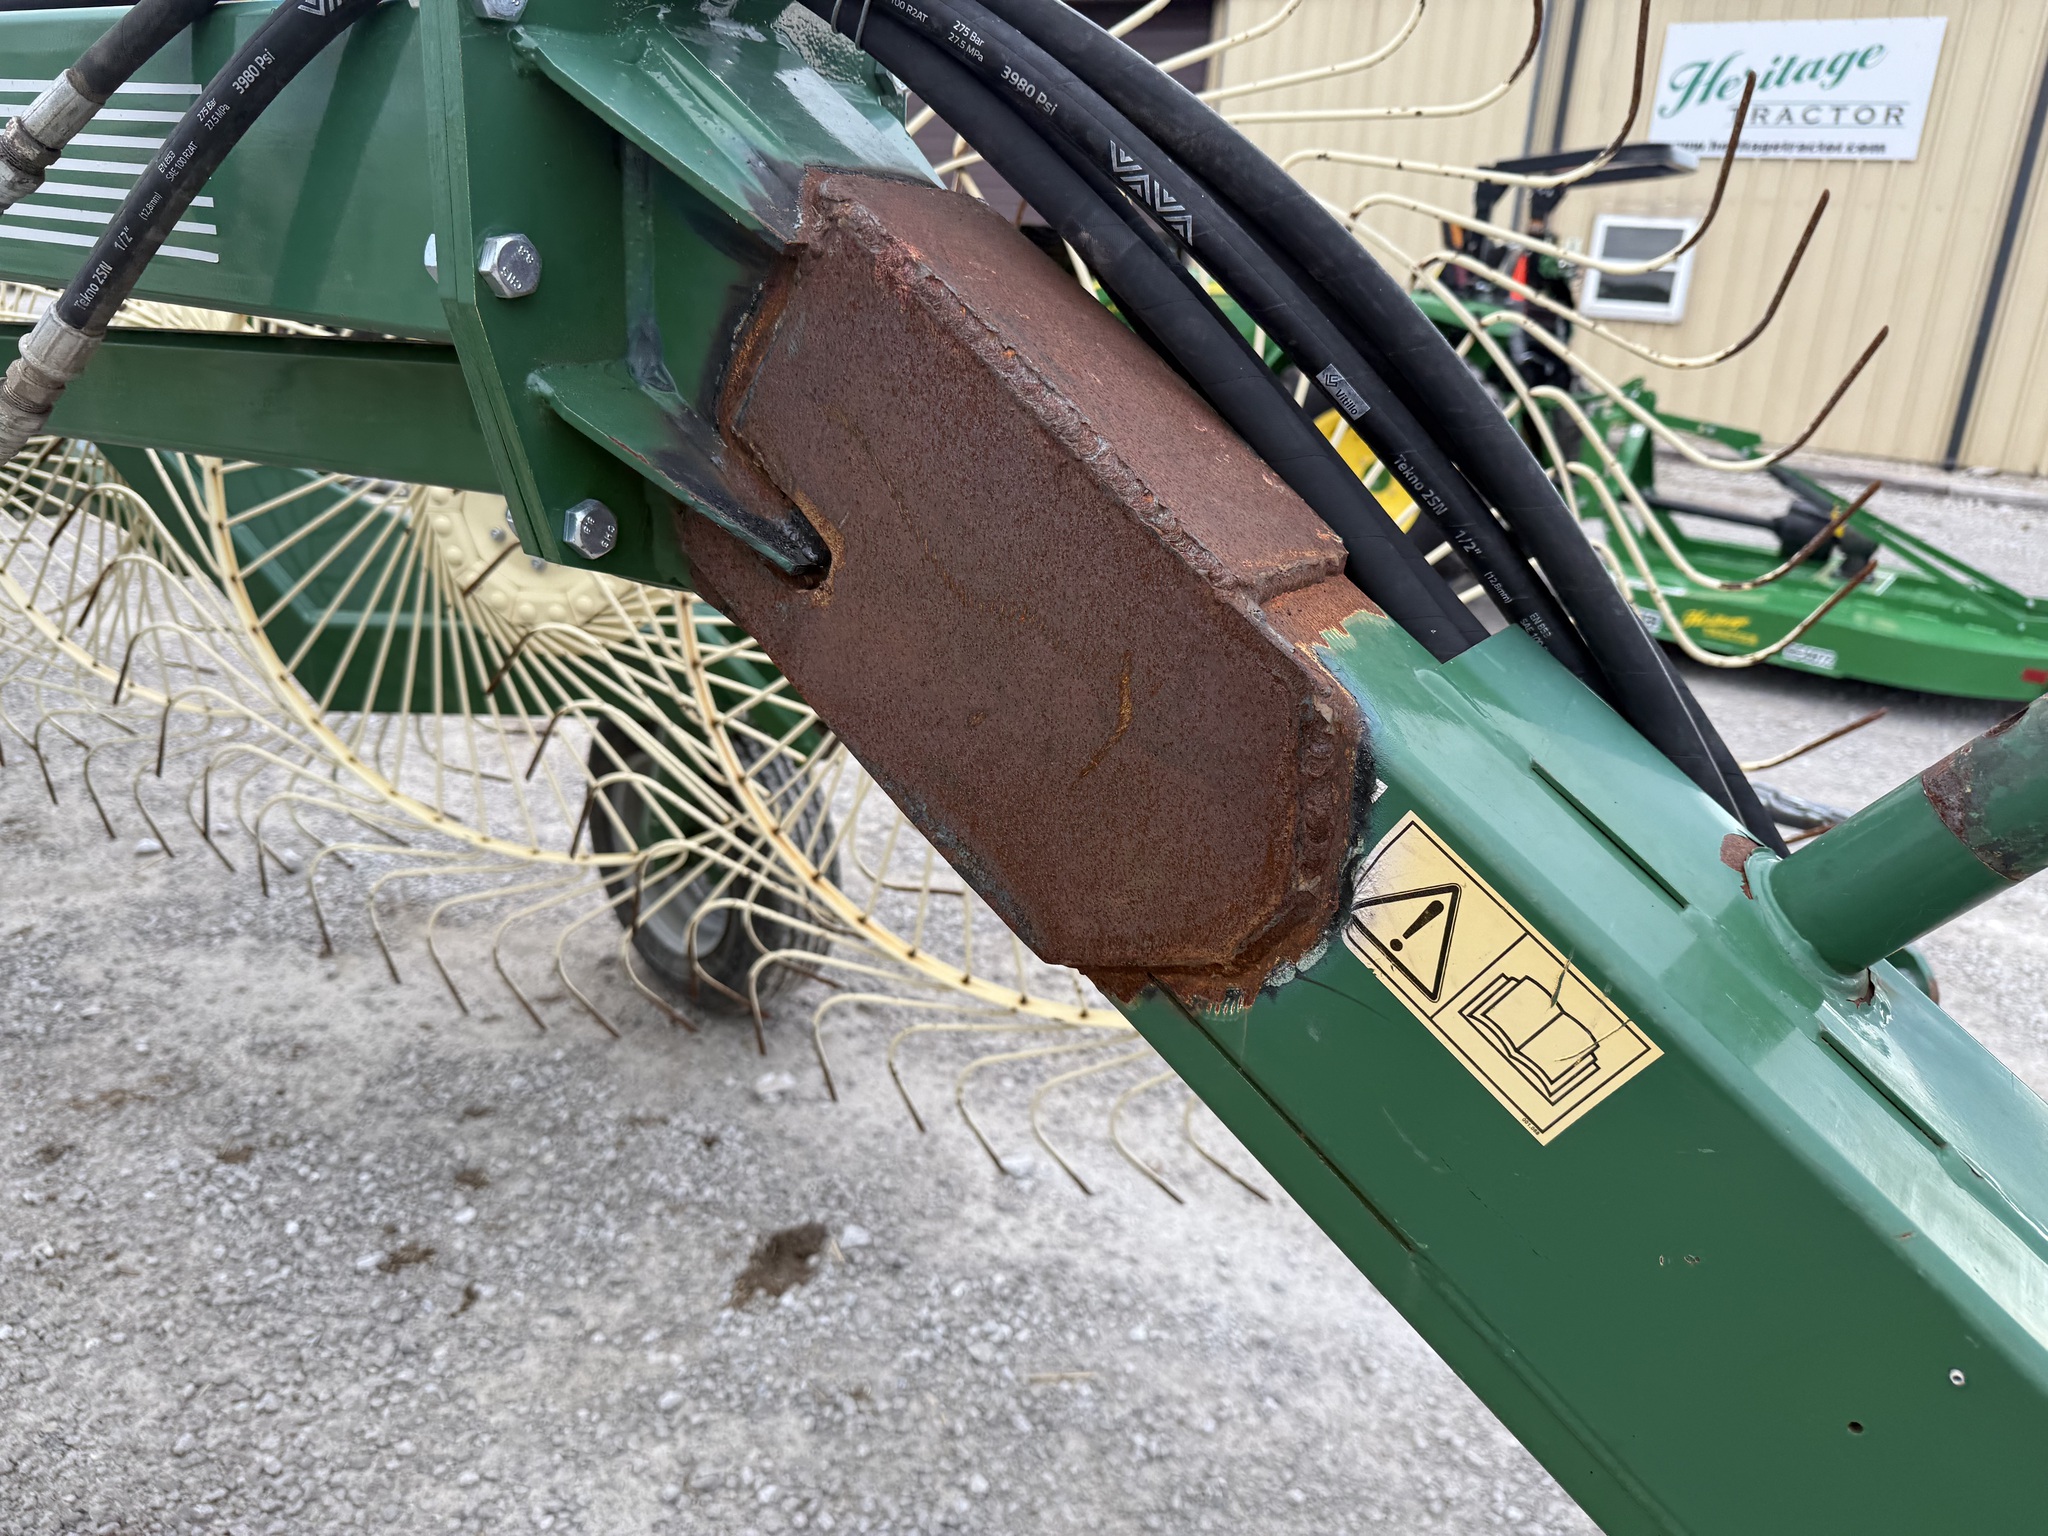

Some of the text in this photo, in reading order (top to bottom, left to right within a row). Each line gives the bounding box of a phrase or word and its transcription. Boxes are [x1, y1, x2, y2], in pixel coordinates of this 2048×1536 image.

[905, 4, 929, 23] R2AT
[947, 31, 984, 63] 27.5 MPa
[952, 20, 985, 47] 275 Bar
[231, 48, 276, 95] 3980 Psi
[1657, 43, 1888, 118] Heitage
[1000, 65, 1058, 116] 3980 Psi
[196, 98, 217, 122] 275 Bar
[217, 103, 231, 119] MPa
[157, 150, 176, 174] EN 853
[165, 140, 198, 182] SAE 100 R2AT
[74, 260, 113, 311] Tekno 2SN
[1336, 389, 1358, 415] Vitillo
[1394, 454, 1448, 516] Tekno 2SN
[1519, 618, 1535, 634] SAE
[1529, 612, 1552, 639] EN 853
